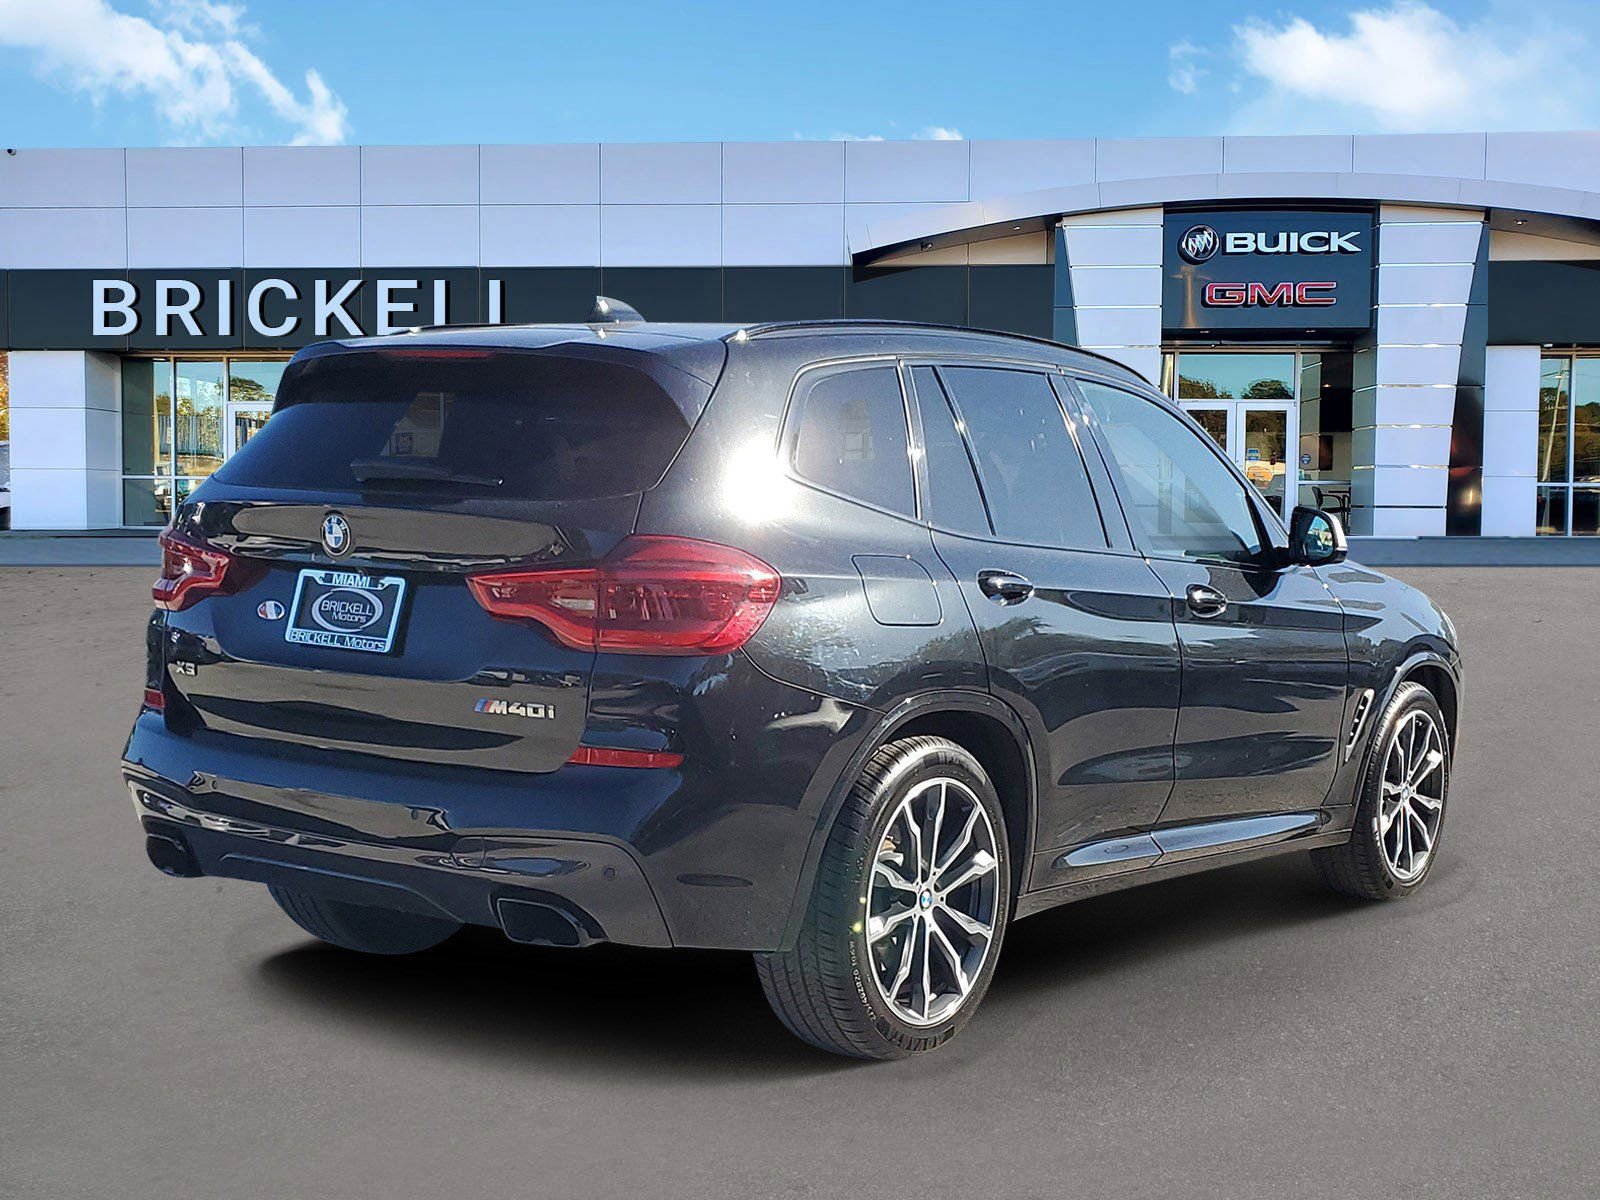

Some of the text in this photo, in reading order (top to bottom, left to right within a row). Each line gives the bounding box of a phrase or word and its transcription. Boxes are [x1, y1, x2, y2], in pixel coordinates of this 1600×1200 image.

[1225, 231, 1362, 253] BUICK
[1205, 281, 1337, 305] GMC
[332, 573, 371, 588] MIAMI
[320, 600, 373, 616] BRICKELL
[331, 612, 367, 623] Motors
[290, 631, 386, 652] BRICKELL Motors
[176, 660, 196, 676] X3
